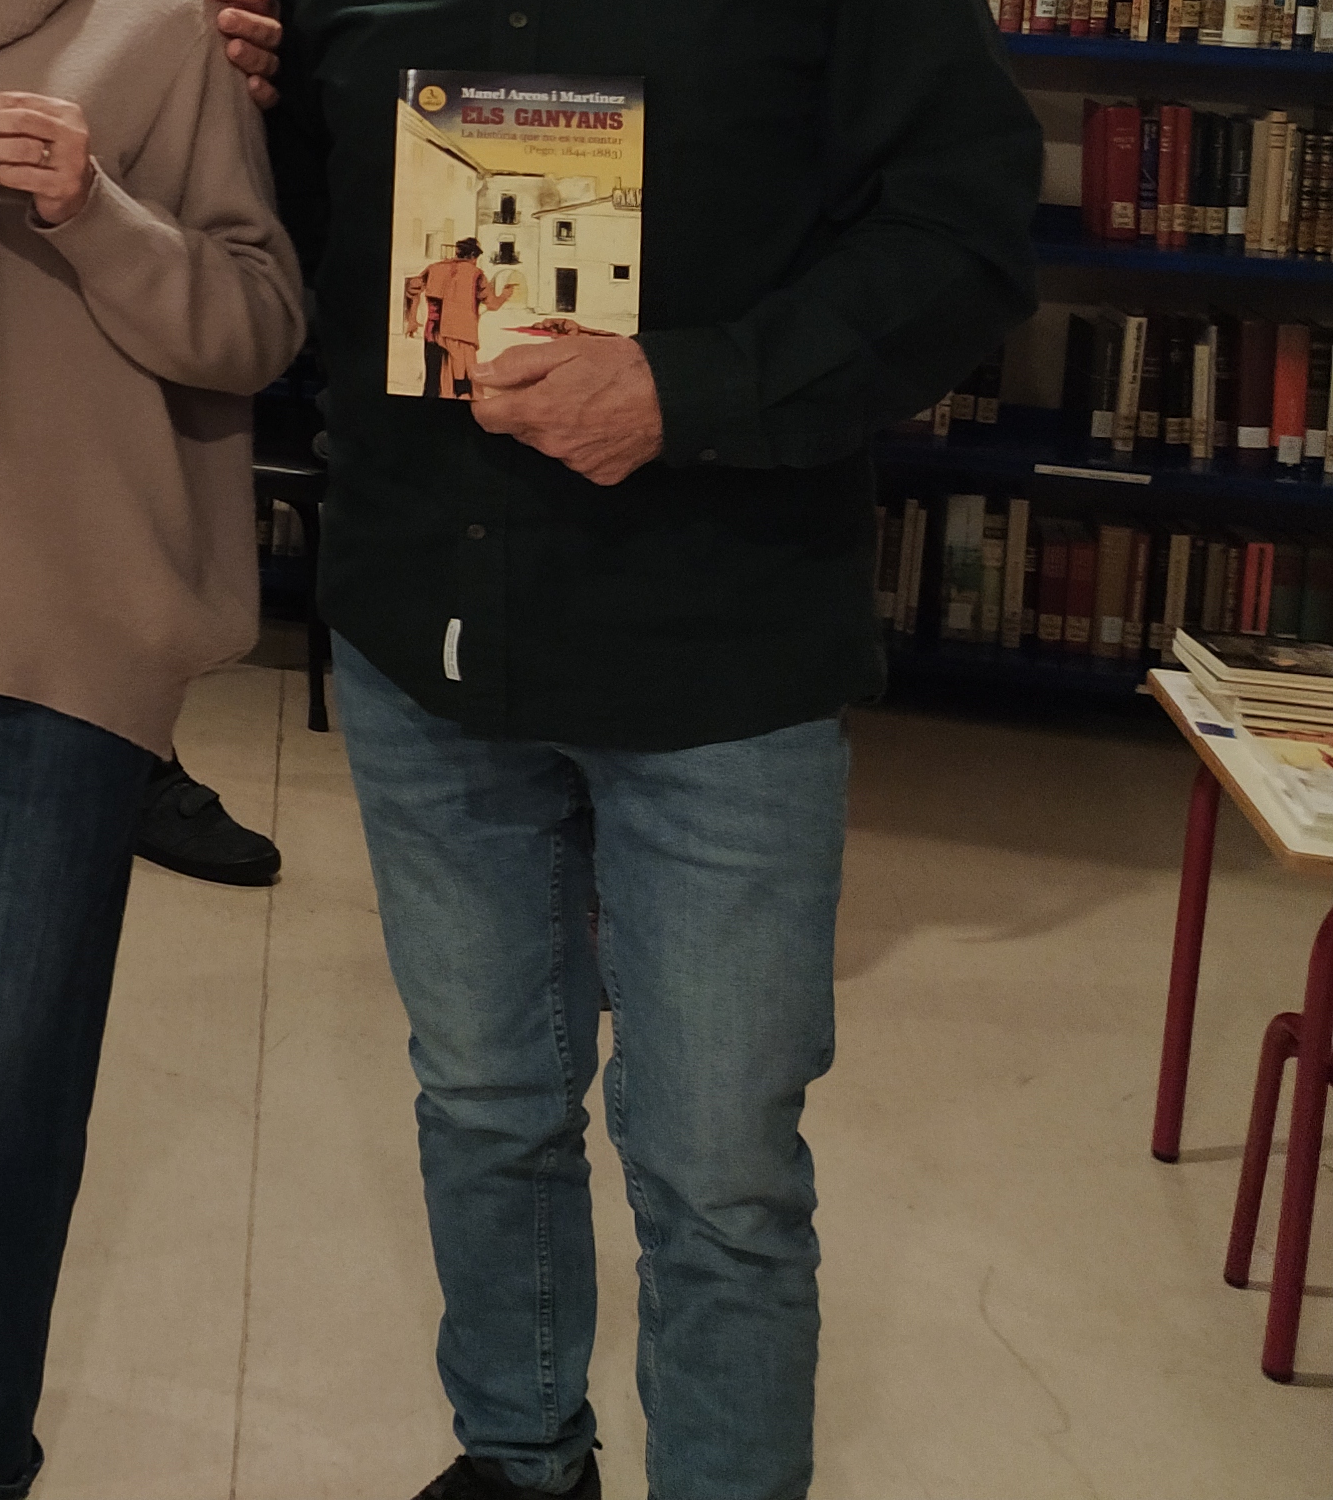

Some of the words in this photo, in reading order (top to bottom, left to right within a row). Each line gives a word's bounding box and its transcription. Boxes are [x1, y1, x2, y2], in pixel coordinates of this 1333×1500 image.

[461, 87, 505, 100] Manel
[508, 89, 549, 101] Arcos
[551, 90, 557, 101] i
[560, 91, 625, 104] Martínez
[461, 105, 504, 125] ELS
[514, 108, 624, 130] GANYANS
[461, 129, 473, 138] La
[521, 132, 540, 143] que
[543, 134, 557, 142] no
